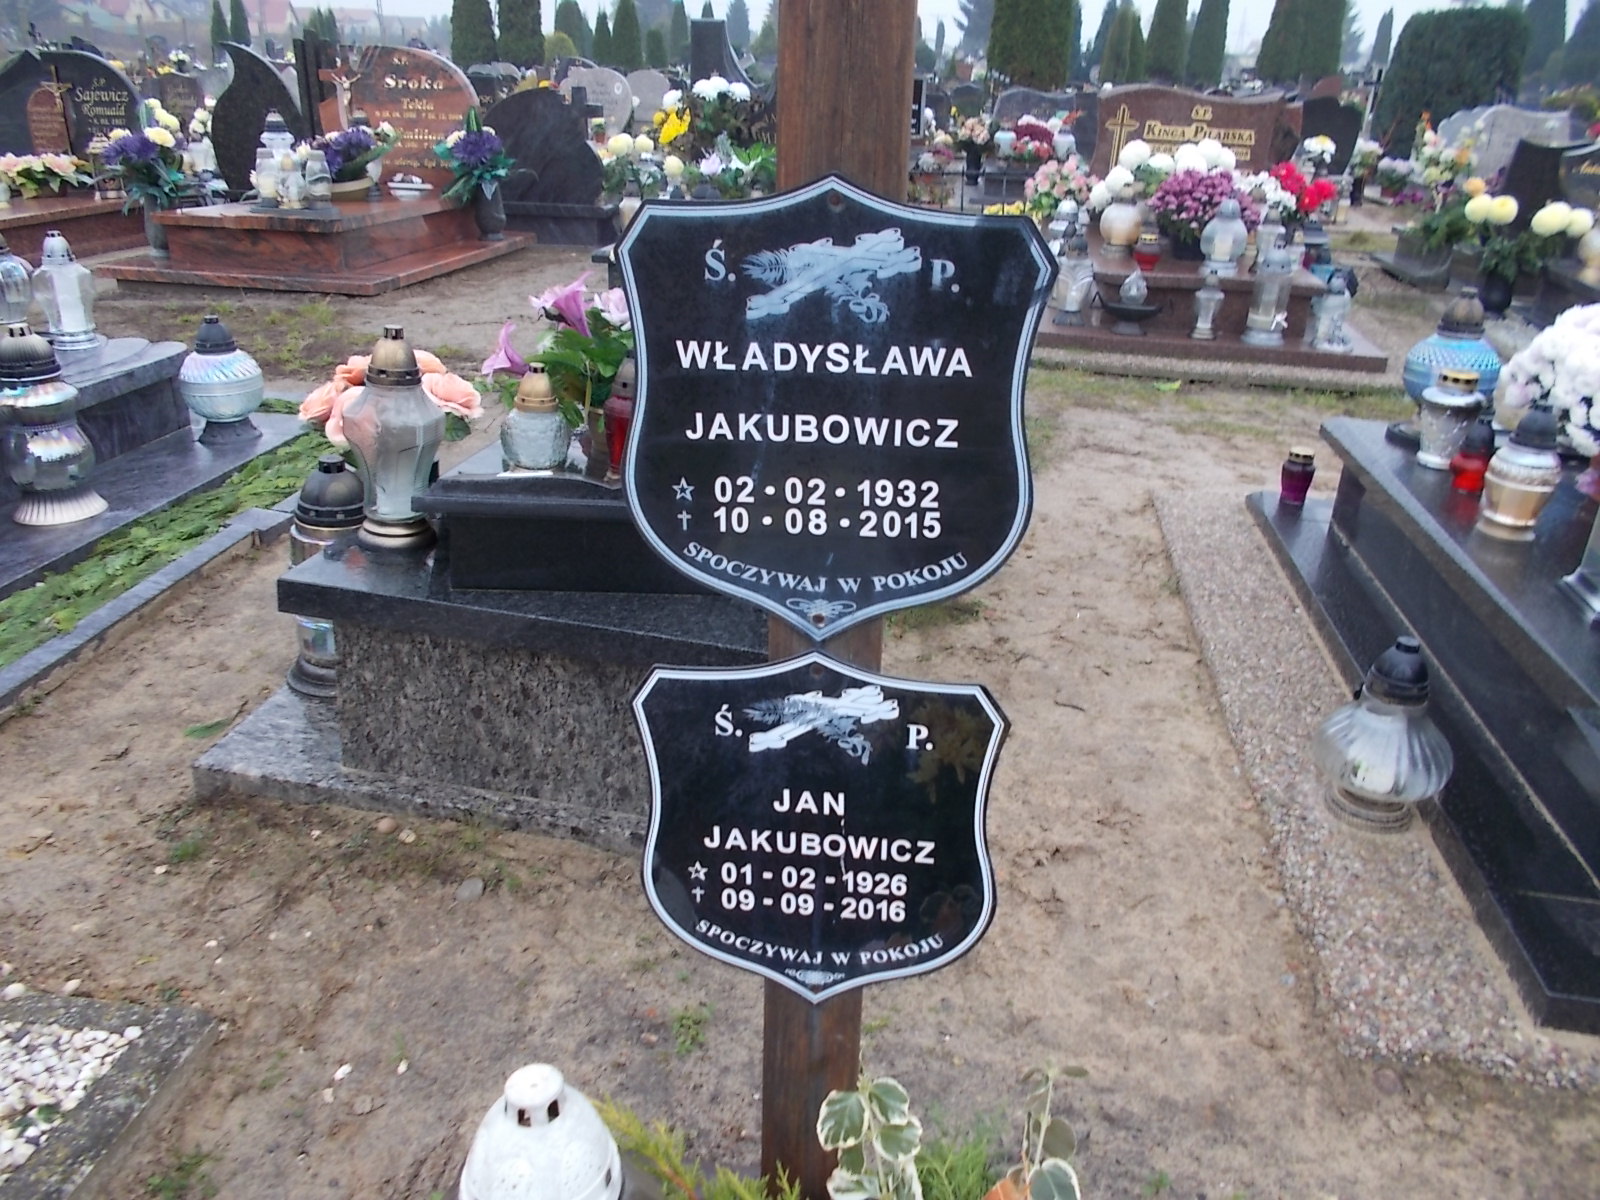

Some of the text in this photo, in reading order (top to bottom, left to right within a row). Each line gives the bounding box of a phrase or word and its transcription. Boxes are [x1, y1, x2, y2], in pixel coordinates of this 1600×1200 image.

[75, 87, 129, 104] Sajewicz
[384, 73, 444, 90] Sroka
[81, 103, 127, 118] Romuald
[401, 97, 434, 111] Tekla
[704, 239, 960, 293] Ś. P.
[675, 339, 973, 378] WŁADYSŁAWA
[685, 412, 959, 449] JAKUBOWICZ
[857, 478, 939, 509] 1932
[859, 511, 942, 539] 2015
[683, 542, 969, 594] SPOCZYWAJ W POKOJU
[714, 704, 934, 751] Ś. P.
[773, 788, 845, 816] JAN
[703, 825, 936, 865] JAKUBOWICZ
[695, 918, 944, 966] SPOCZYWAJ W POKOJU
